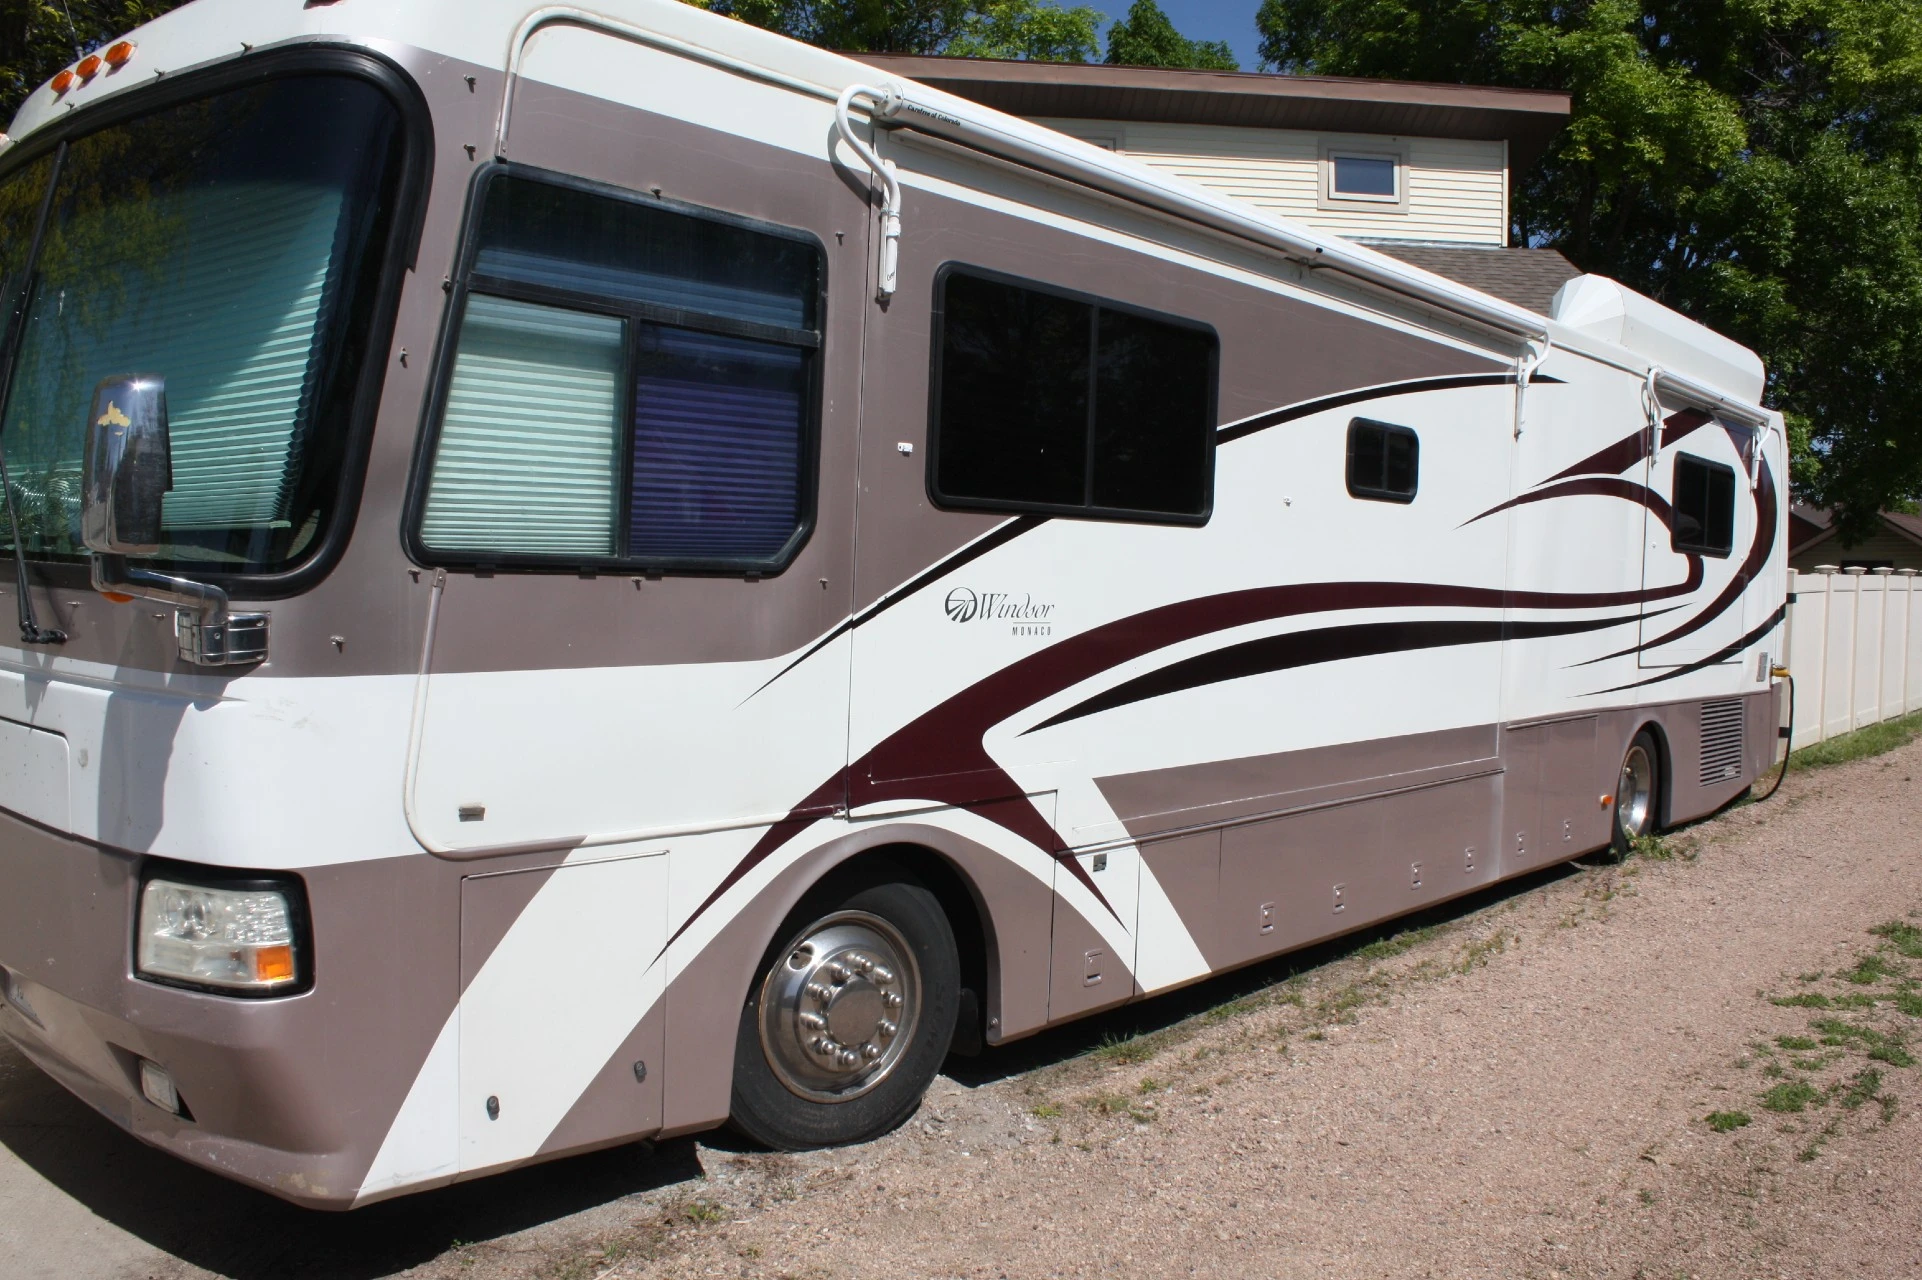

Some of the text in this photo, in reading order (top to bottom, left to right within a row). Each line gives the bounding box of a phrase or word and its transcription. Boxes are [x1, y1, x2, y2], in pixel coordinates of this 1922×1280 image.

[908, 104, 931, 117] Carefree
[938, 114, 961, 126] Colorado
[979, 592, 1055, 620] Windsor
[1012, 626, 1051, 636] MONACO
